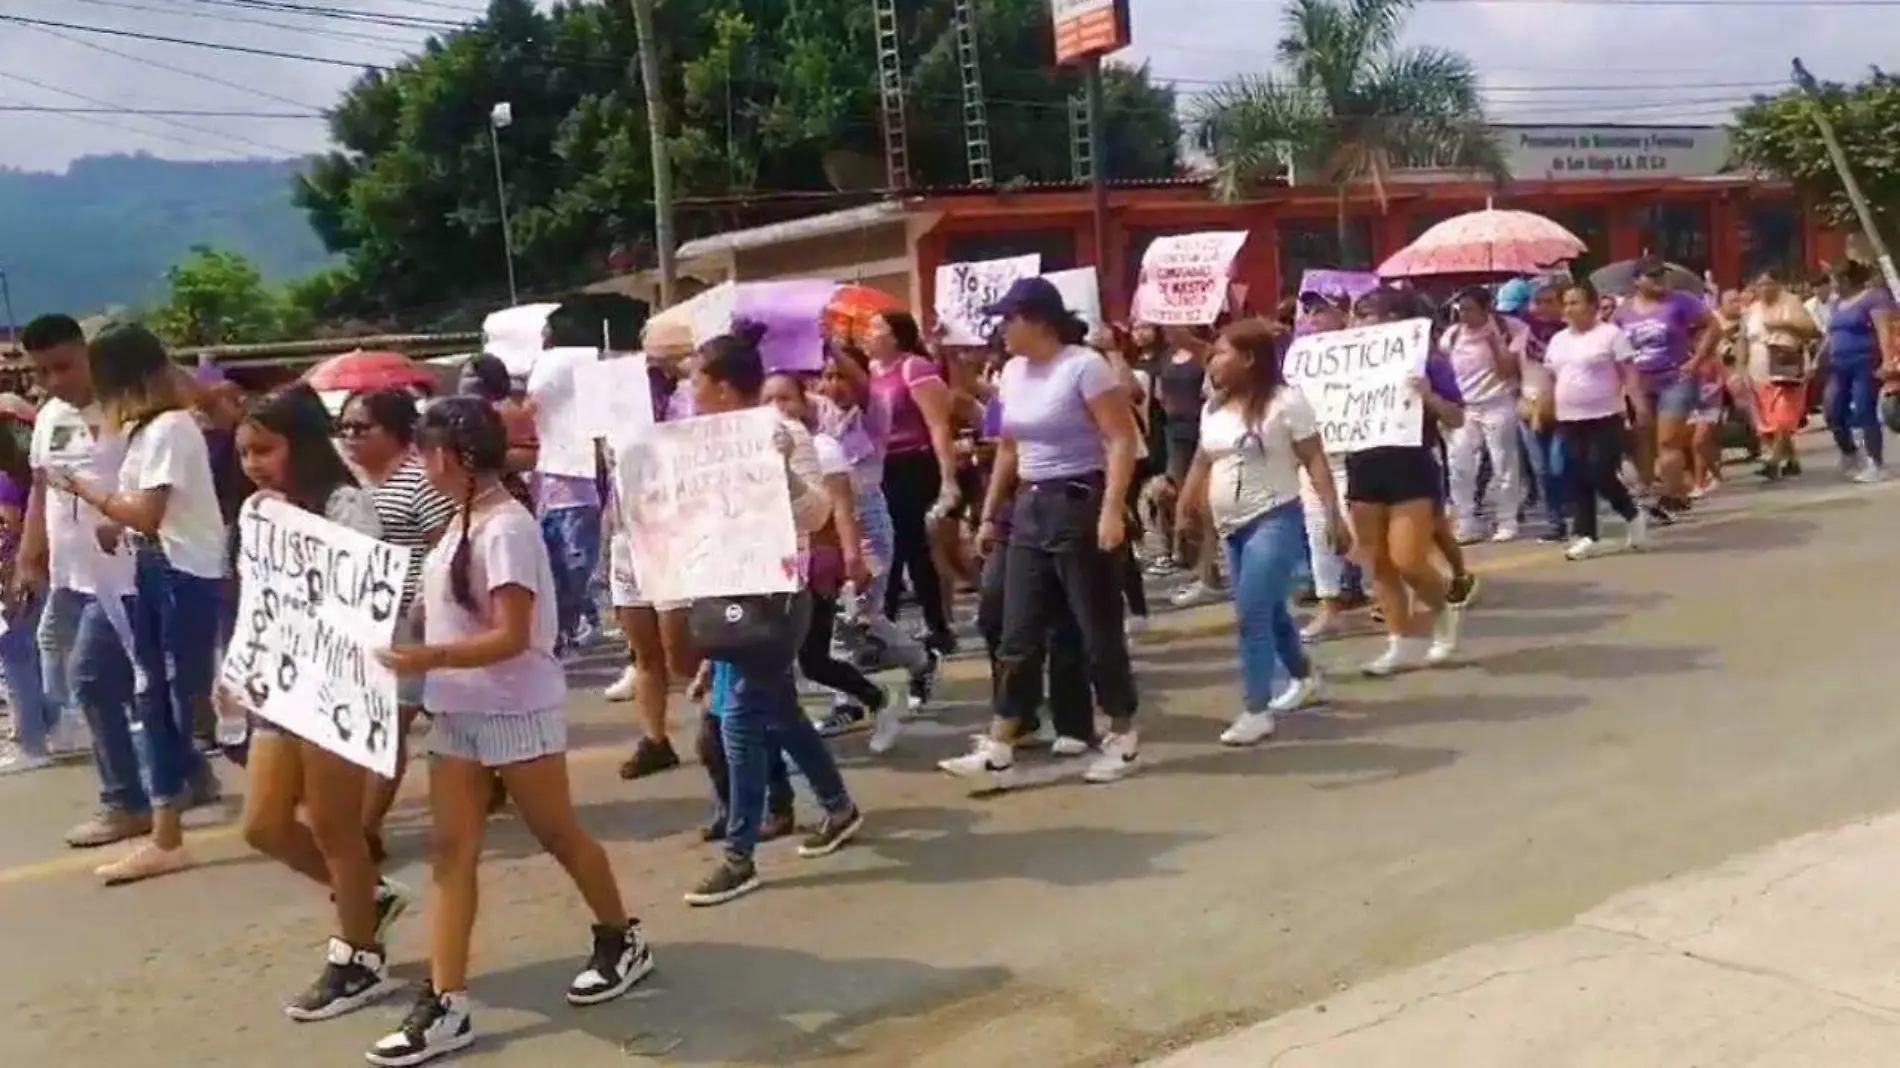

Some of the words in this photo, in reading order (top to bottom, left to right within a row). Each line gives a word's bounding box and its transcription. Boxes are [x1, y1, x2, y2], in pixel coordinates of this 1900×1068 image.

[1286, 336, 1406, 379] JUSTICIA
[1342, 382, 1397, 418] MIMI
[247, 511, 378, 610] JUSTICIA
[312, 619, 367, 688] MIMI
